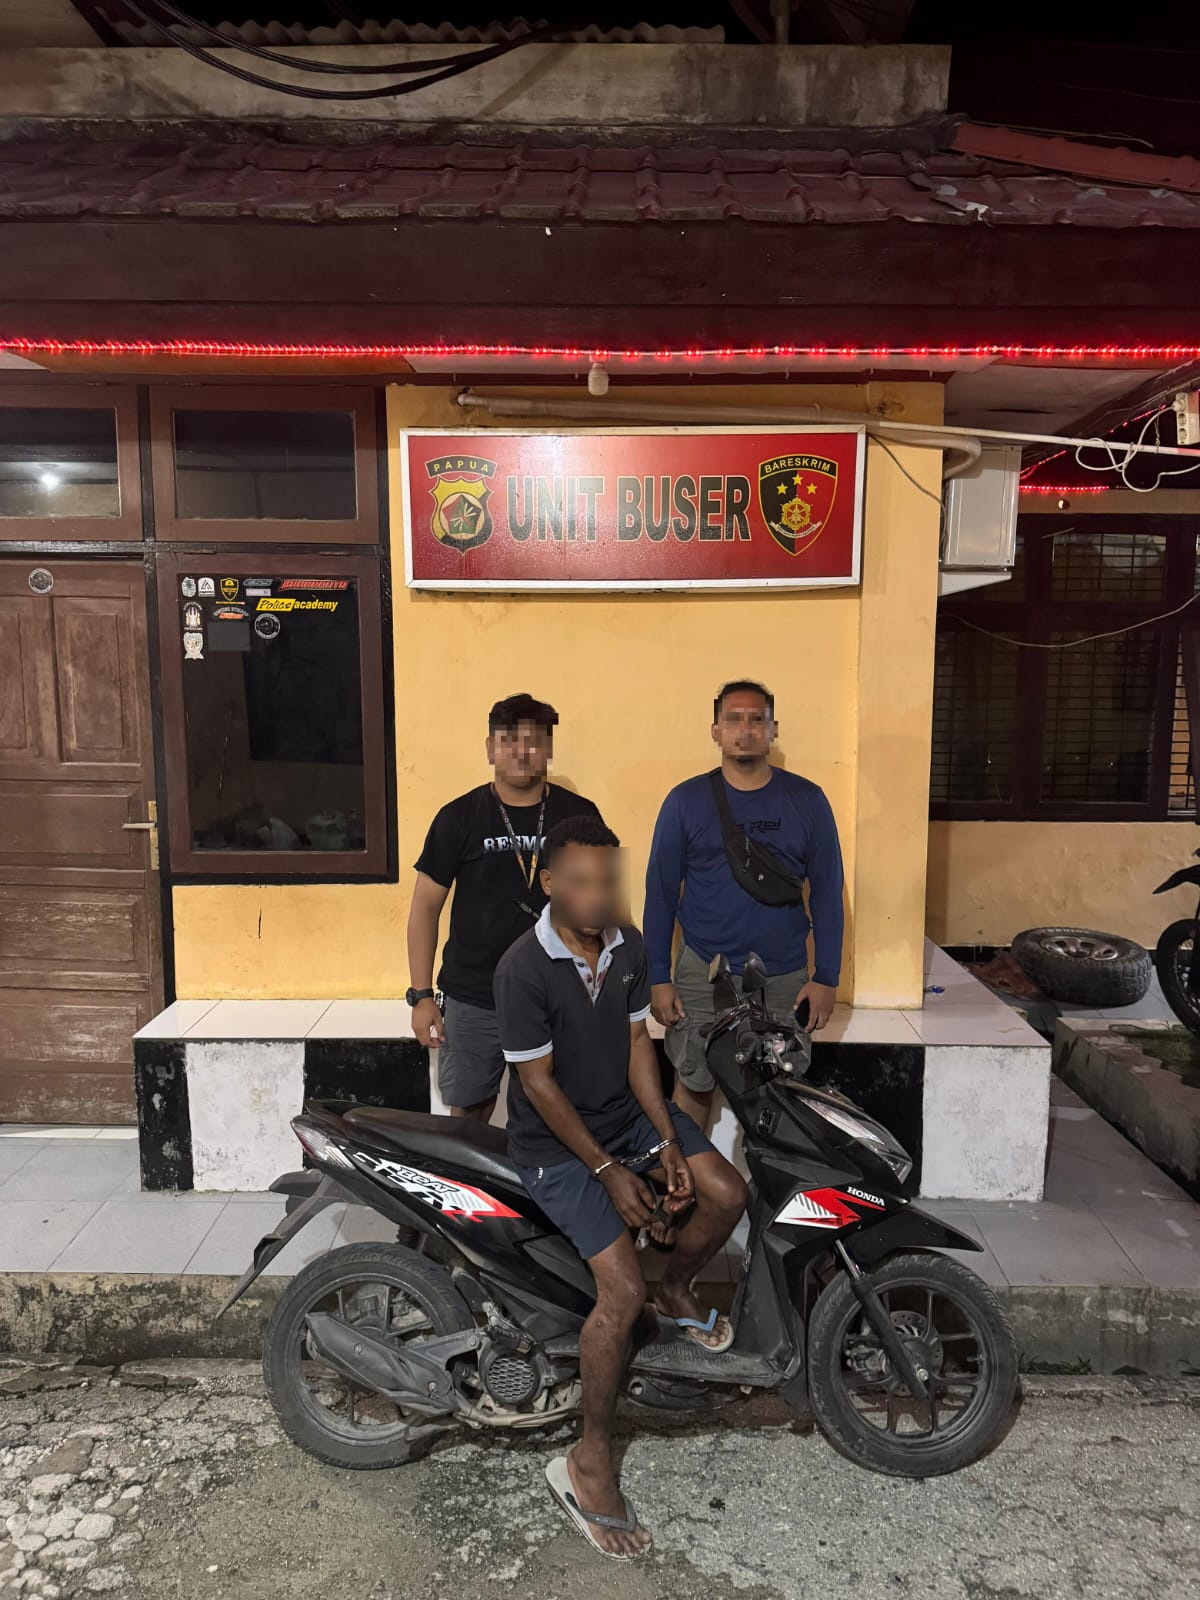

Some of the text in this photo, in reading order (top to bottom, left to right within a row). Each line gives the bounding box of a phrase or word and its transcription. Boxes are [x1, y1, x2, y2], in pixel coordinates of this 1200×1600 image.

[433, 460, 489, 473] PAPUA
[764, 457, 831, 474] BARESKRIM
[507, 474, 752, 543] UNIT BUSER
[258, 599, 339, 612] Police academy
[847, 1186, 885, 1206] HONDA
